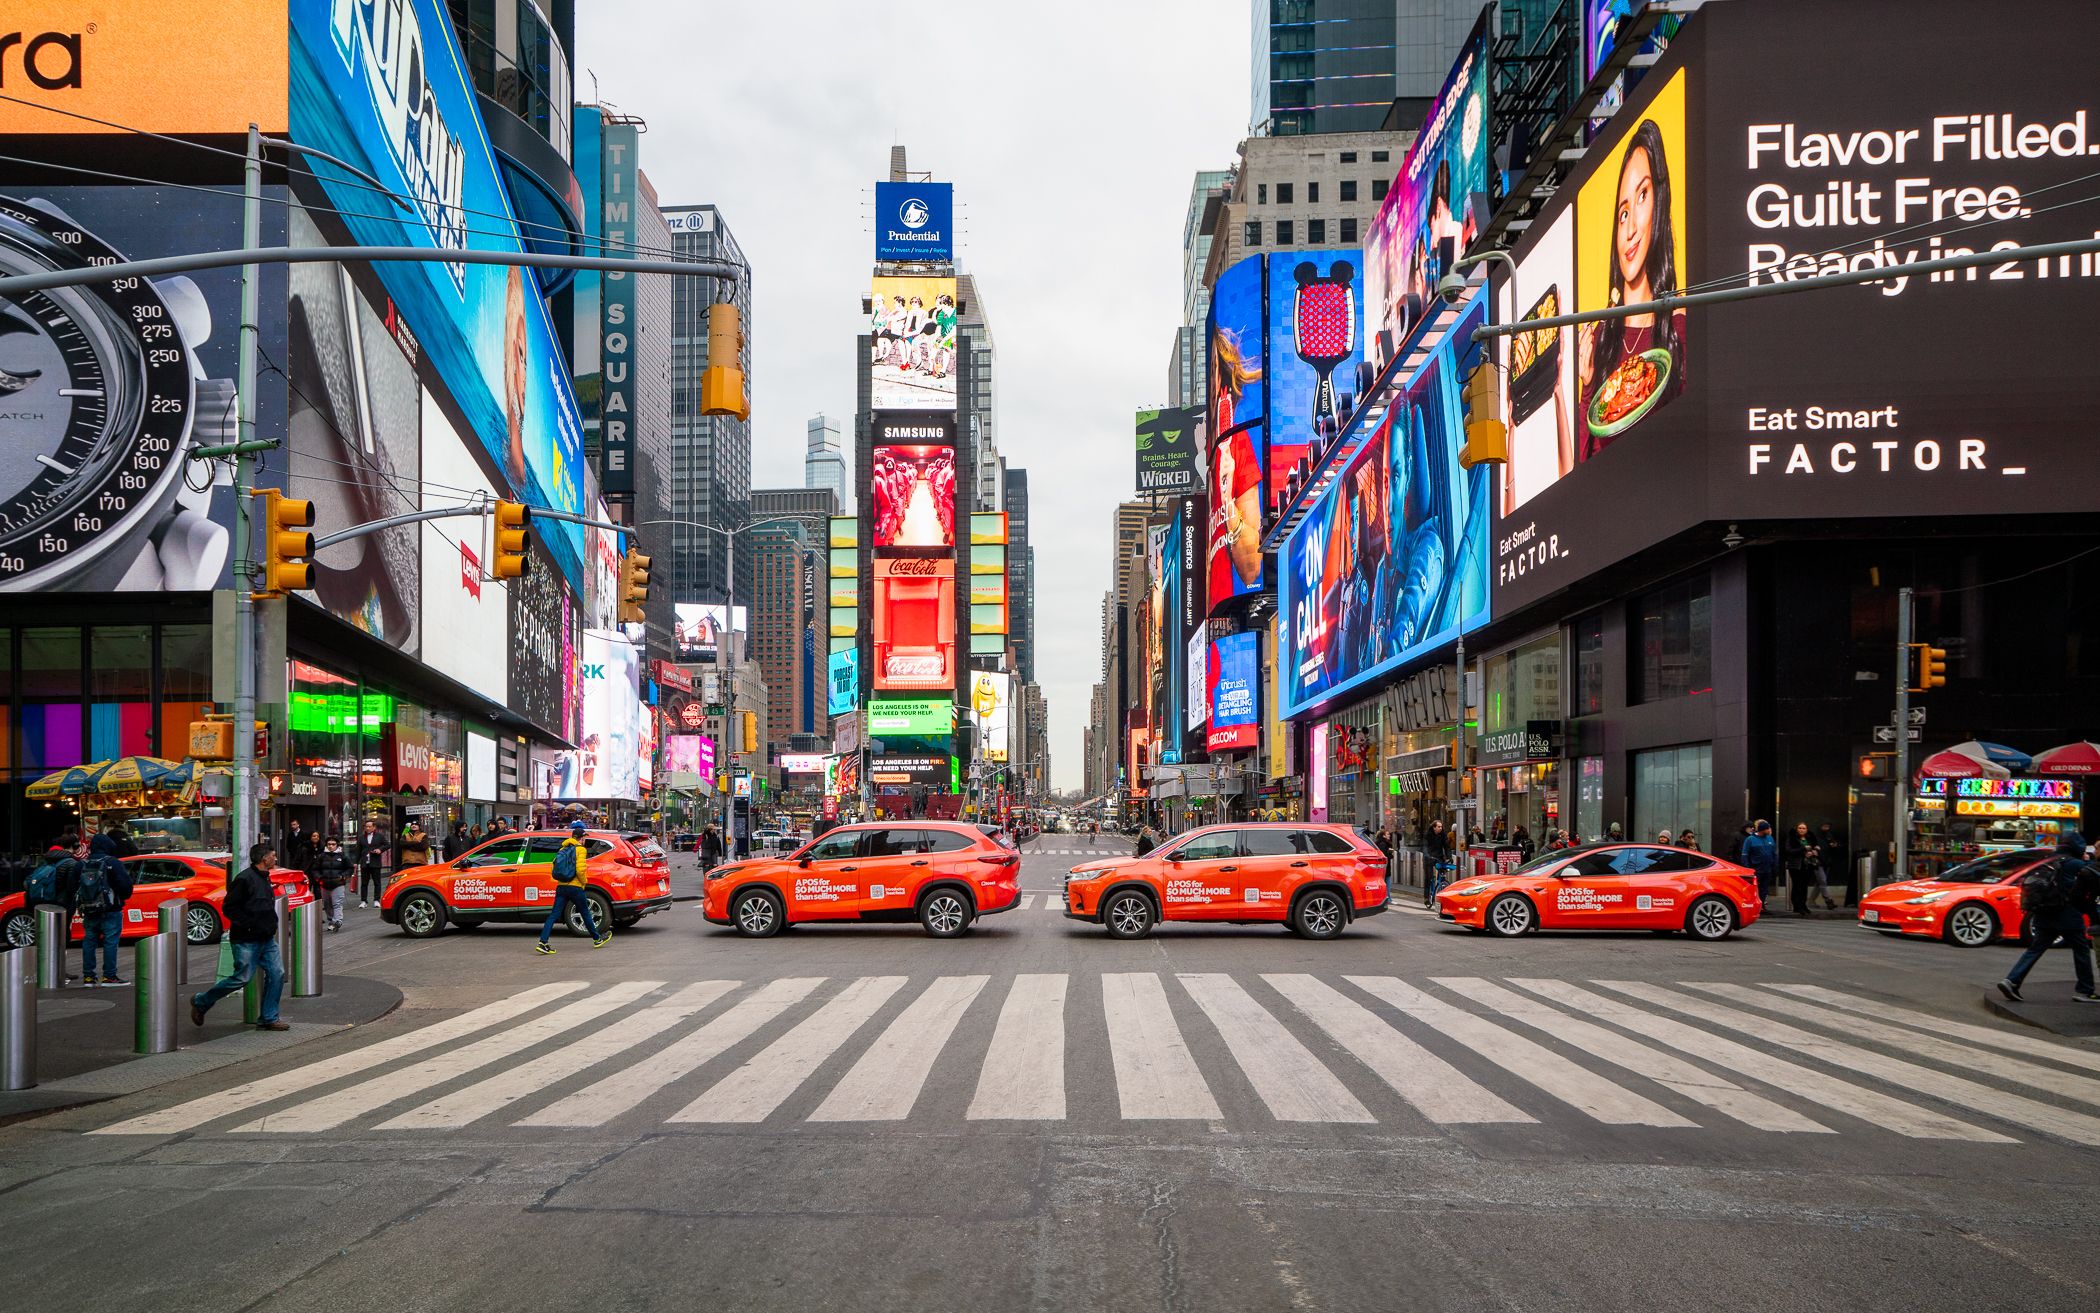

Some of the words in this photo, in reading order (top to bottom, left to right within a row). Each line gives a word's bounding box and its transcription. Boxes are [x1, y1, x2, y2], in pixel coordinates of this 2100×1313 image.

[1748, 123, 1919, 170] Flavor
[1933, 110, 2100, 162] Filled.
[1747, 181, 1881, 229] Guilt
[1895, 178, 2032, 224] Free.
[53, 232, 82, 245] 500
[887, 230, 941, 242] Prudential
[1748, 240, 1919, 298] Ready
[1930, 237, 1977, 283] in
[1990, 241, 2024, 280] 2
[132, 305, 162, 319] 300
[142, 325, 172, 339] 275
[150, 350, 180, 363] 250
[605, 303, 629, 471] SQUARE
[151, 400, 182, 413] 225
[1749, 408, 1798, 431] Eat
[1805, 406, 1898, 430] Smart
[884, 426, 944, 438] SAMSUNG
[139, 438, 170, 451] 200
[133, 456, 160, 470] 190
[1142, 453, 1167, 462] Brains.
[1168, 451, 1190, 459] Heart.
[1150, 460, 1181, 468] Courage.
[119, 475, 146, 489] 180
[99, 496, 125, 511] 170
[74, 517, 102, 532] 160
[39, 538, 67, 553] 150
[1500, 536, 1513, 557] Eat
[1512, 521, 1536, 549] Smart
[1186, 525, 1194, 570] Severance
[1305, 519, 1323, 588] ON
[889, 559, 939, 575] Coca-Cola
[1296, 582, 1327, 651] CALL
[517, 600, 557, 672] SEPHORA
[1218, 698, 1253, 710] DETANGLING
[1219, 708, 1230, 717] HAIR
[1230, 706, 1252, 716] BRUSH
[1485, 737, 1497, 753] U.S.
[1498, 732, 1518, 751] POLO
[1519, 731, 1527, 748] A
[100, 781, 141, 792] SABRETT
[292, 782, 313, 796] swatch
[1397, 773, 1423, 792] OREVER
[833, 884, 856, 892] MORE
[1205, 887, 1231, 895] MORE
[1583, 887, 1595, 895] for
[470, 892, 496, 901] selling.
[814, 892, 839, 901] selling.
[1185, 894, 1212, 904] selling.
[1557, 895, 1570, 903] SO
[1597, 894, 1623, 902] MORE
[1557, 902, 1576, 910] than
[1576, 902, 1604, 911] selling.
